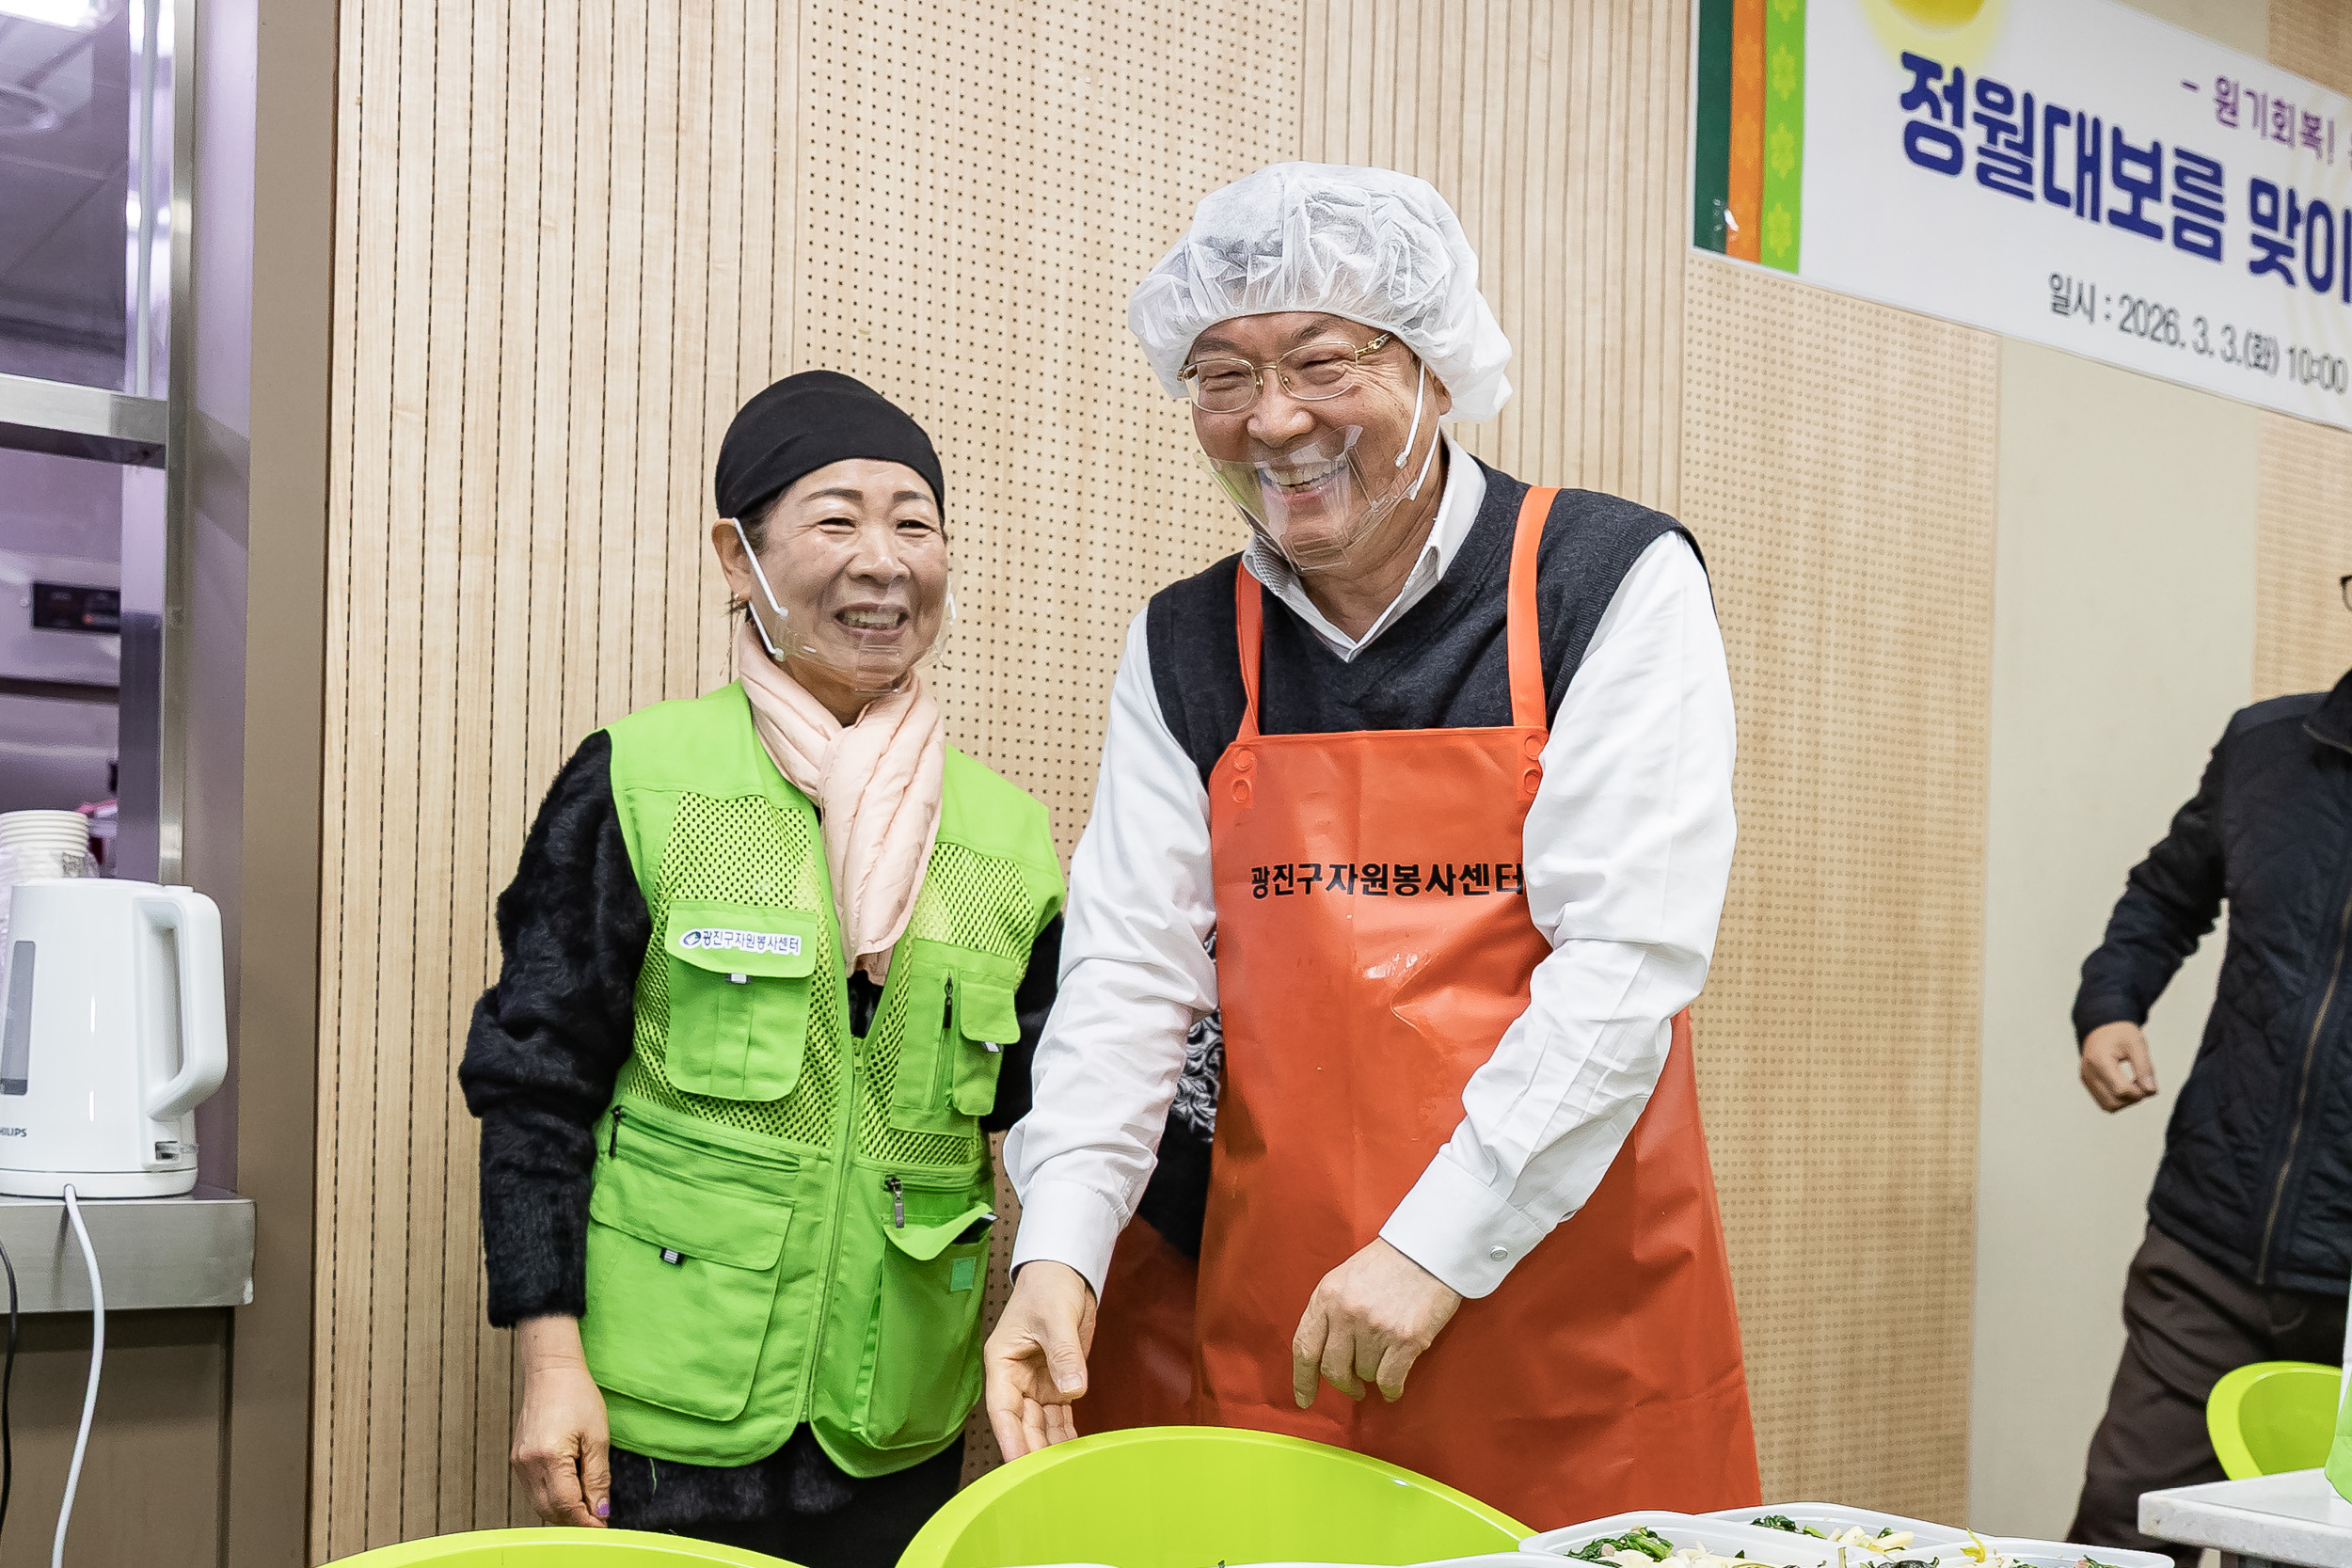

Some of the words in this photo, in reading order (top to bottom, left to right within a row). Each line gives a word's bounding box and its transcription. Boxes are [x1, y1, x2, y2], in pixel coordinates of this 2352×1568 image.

[1899, 50, 2224, 262] 정월대보름
[2249, 177, 2351, 304] 맞이
[2049, 272, 2095, 324] 일시
[2119, 293, 2185, 348] 2026.
[2287, 346, 2349, 395] 10:00
[1250, 863, 1523, 899] 광진구자원봉사센터
[703, 930, 799, 952] 광진구자원봉사센터
